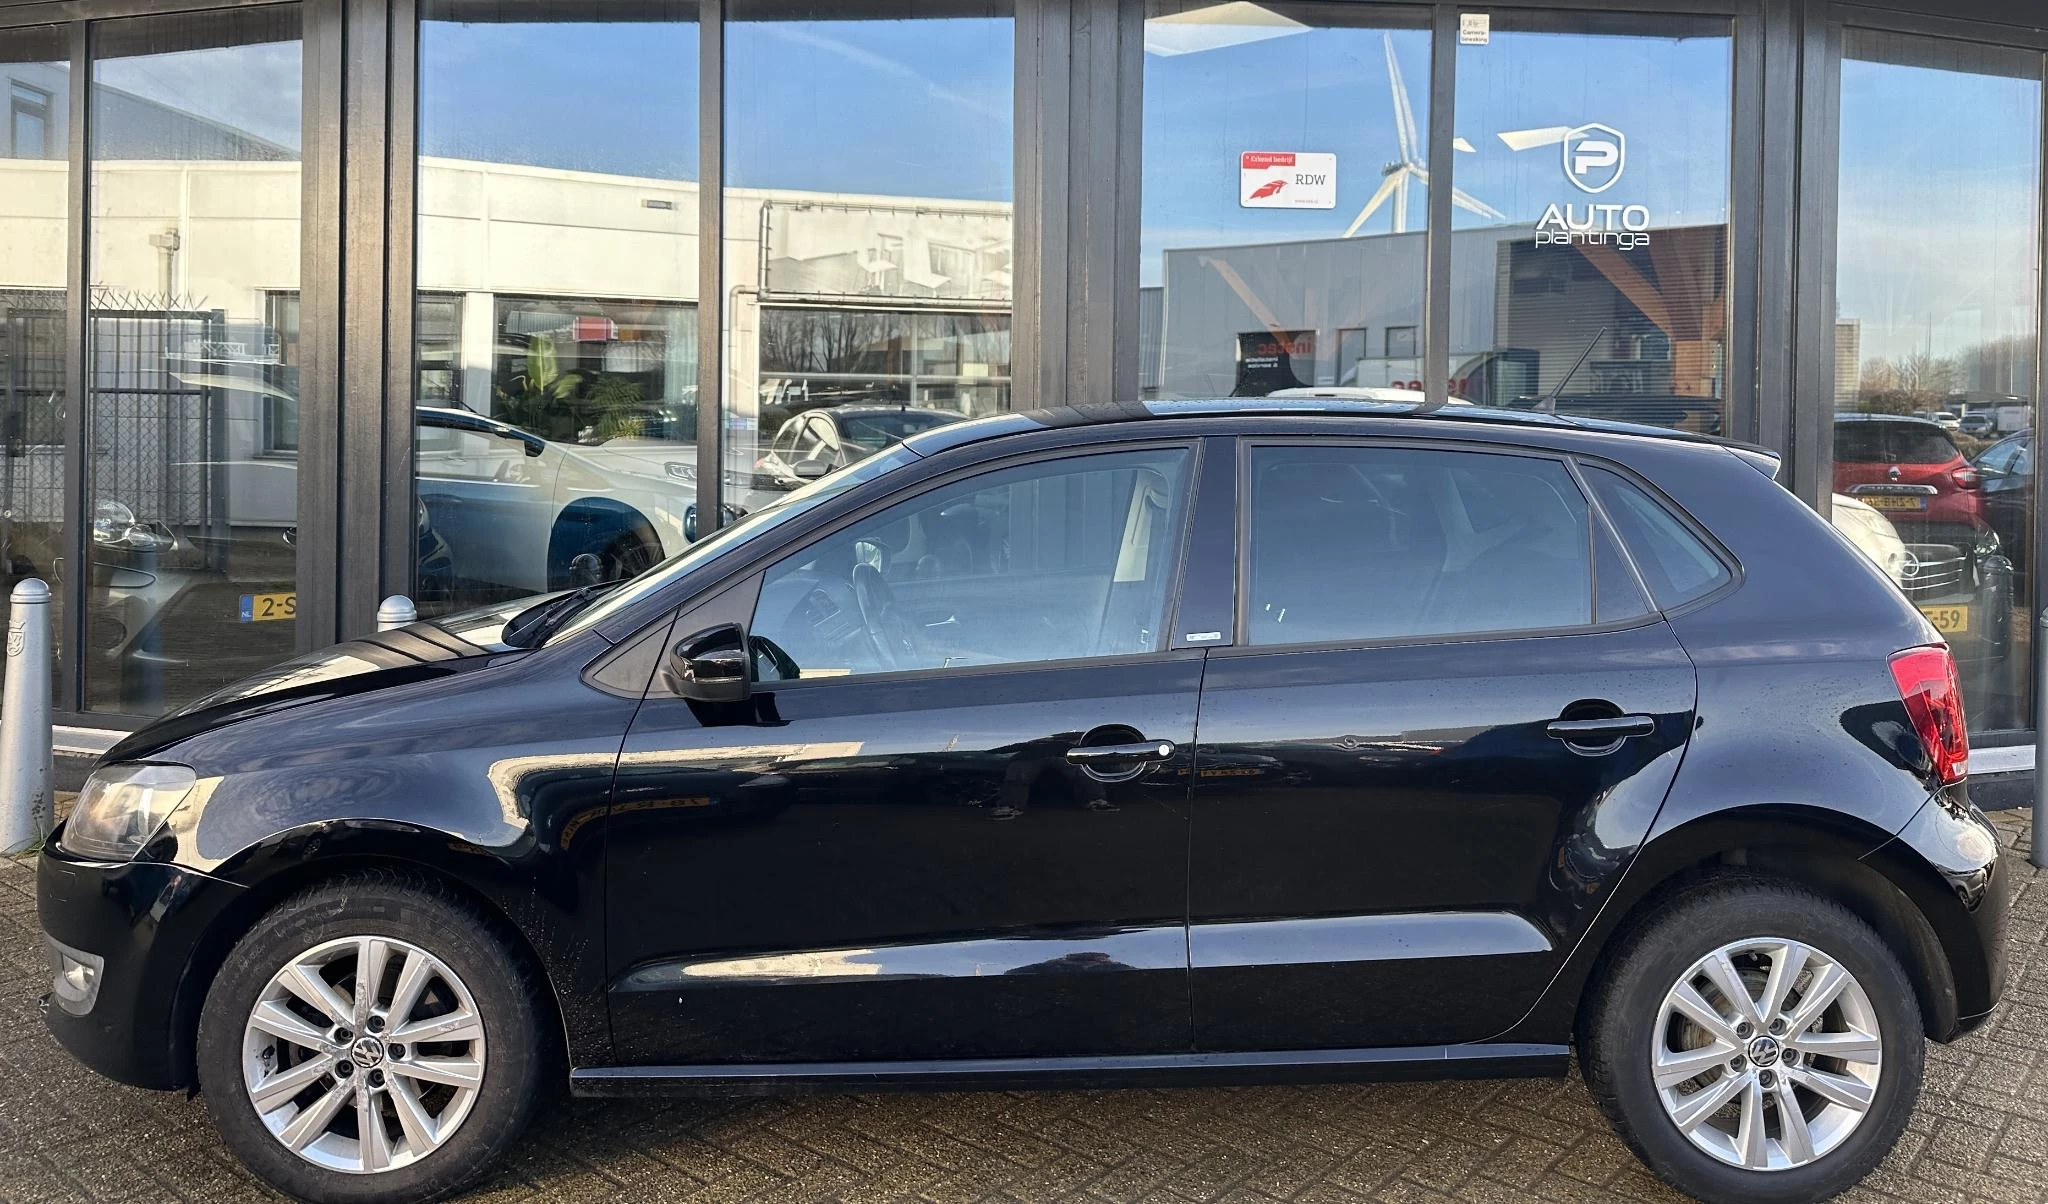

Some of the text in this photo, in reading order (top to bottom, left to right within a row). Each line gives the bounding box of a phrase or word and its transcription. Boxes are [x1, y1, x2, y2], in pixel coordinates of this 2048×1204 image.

[1295, 173, 1326, 184] RDW
[1535, 203, 1650, 231] AUTO
[1535, 228, 1650, 251] plantinga
[1923, 608, 1961, 629] -59
